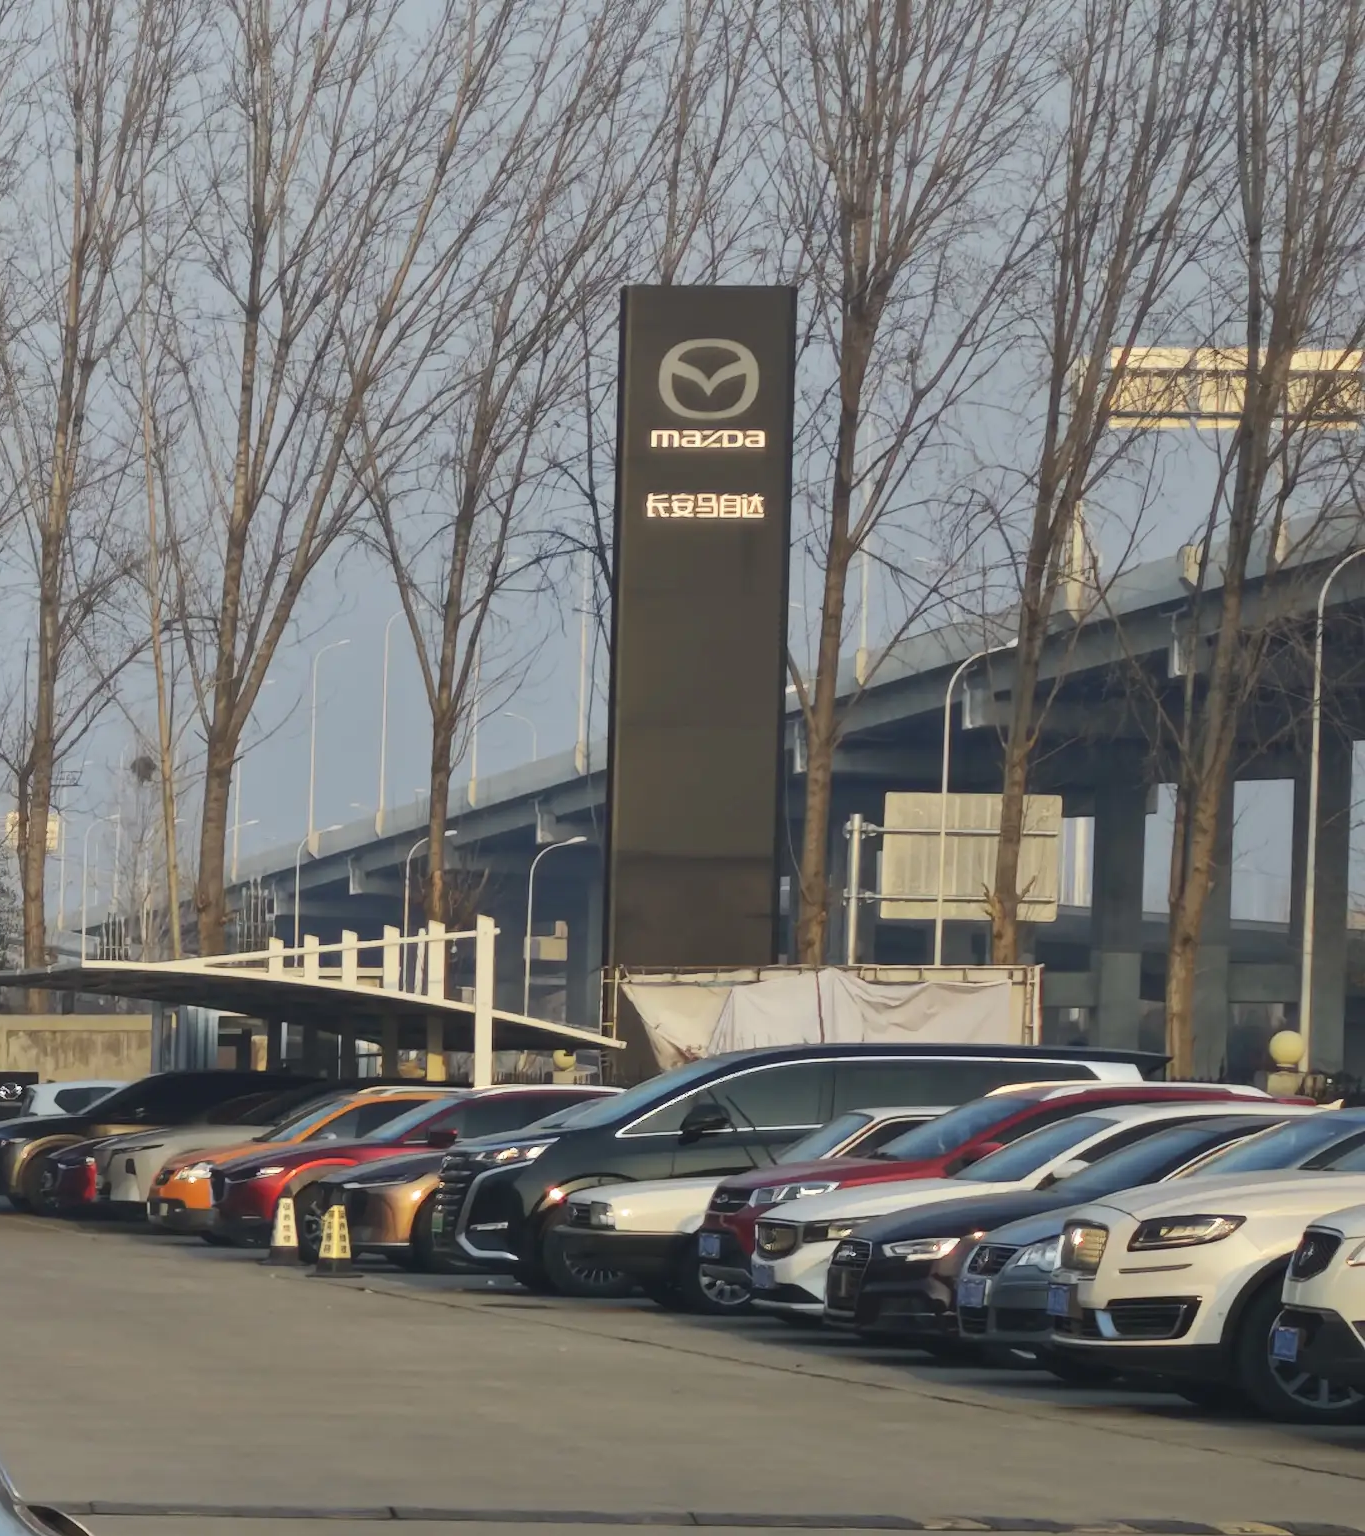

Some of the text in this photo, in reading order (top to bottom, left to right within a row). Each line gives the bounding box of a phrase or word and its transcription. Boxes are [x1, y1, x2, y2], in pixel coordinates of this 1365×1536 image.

[650, 429, 766, 448] mazda
[646, 492, 765, 519] 长安马自达
